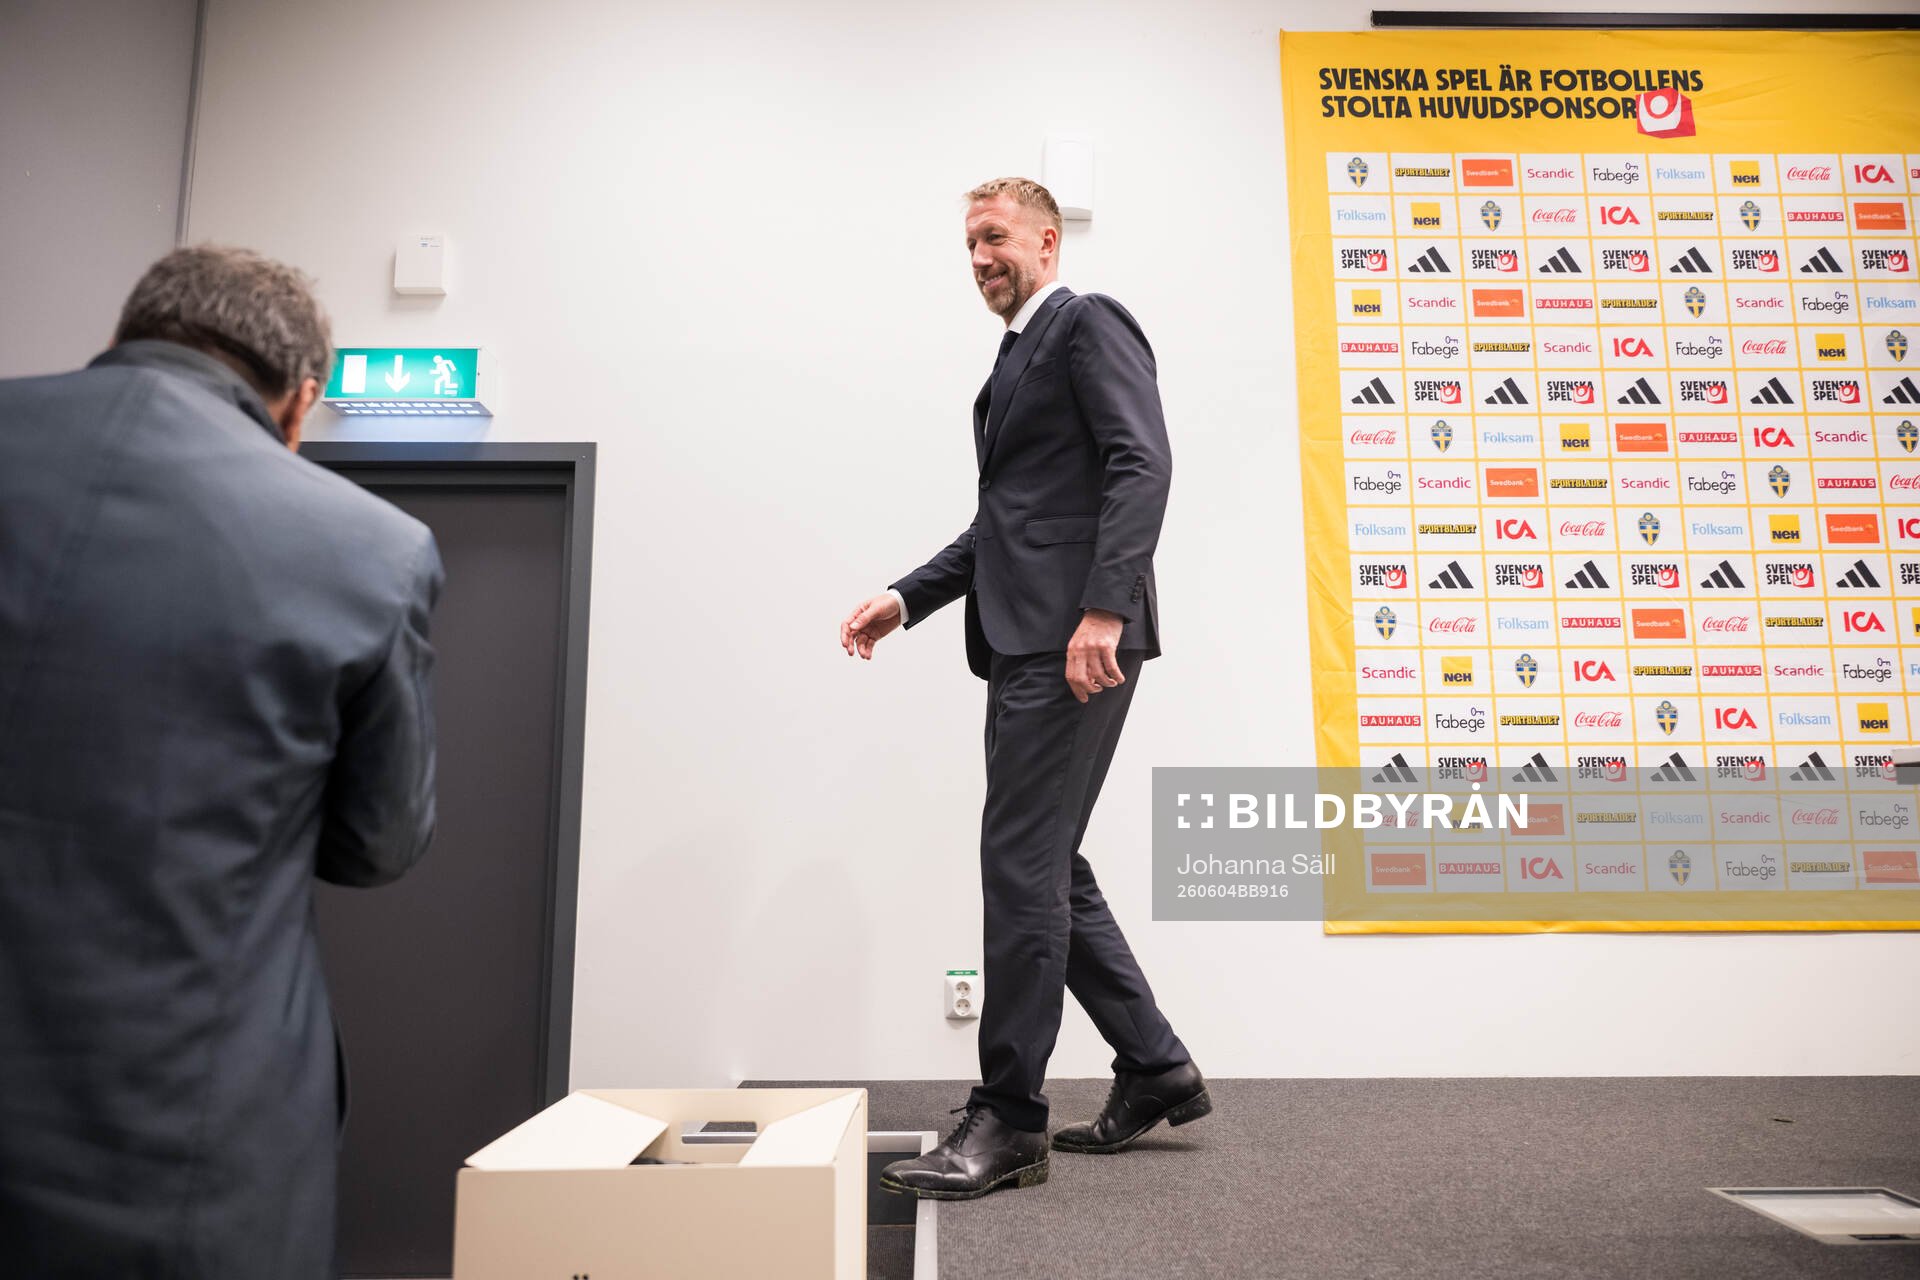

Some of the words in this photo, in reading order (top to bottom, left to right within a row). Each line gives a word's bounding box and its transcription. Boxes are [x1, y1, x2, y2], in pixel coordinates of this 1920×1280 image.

[1319, 67, 1429, 91] SVENSKA
[1437, 68, 1492, 91] SPEL
[1499, 64, 1532, 91] ÄR
[1540, 69, 1704, 92] FOTBOLLENS
[1321, 95, 1412, 118] STOLTA
[1419, 96, 1636, 119] HUVUDSPONSOR
[1395, 167, 1450, 178] SPORTBLADET
[1528, 168, 1574, 178] Scandic
[1593, 168, 1639, 184] Fabege
[1656, 168, 1705, 179] Folksam
[1855, 165, 1894, 183] ICA
[1337, 210, 1386, 220] Folksam
[1600, 206, 1640, 225] ICA
[1657, 211, 1713, 220] SPORTBLADET
[1788, 212, 1843, 221] BAUHAUS
[1342, 259, 1365, 270] SPEL
[1473, 259, 1496, 270] SPEL
[1604, 259, 1627, 270] SPEL
[1733, 259, 1756, 270] SPEL
[1863, 259, 1886, 270] SPEL
[1408, 297, 1456, 307] Scandic
[1537, 299, 1592, 308] BAUHAUS
[1601, 299, 1657, 308] SPORTBLADET
[1736, 297, 1784, 308] Scandic
[1802, 298, 1849, 314] Fabege
[1867, 297, 1916, 308] Folksam
[1342, 343, 1397, 352] BAUHAUS
[1412, 342, 1458, 359] Fabege
[1473, 342, 1530, 352] SPORTBLADET
[1544, 342, 1591, 352] Scandic
[1614, 338, 1653, 357] ICA
[1676, 342, 1722, 359] Fabege
[1415, 391, 1439, 401] SPEL
[1548, 391, 1571, 401] SPEL
[1681, 391, 1705, 401] SPEL
[1813, 391, 1837, 401] SPEL
[1484, 432, 1533, 443] Folksam
[1680, 432, 1736, 443] BAUHAUS
[1754, 428, 1794, 447] ICA
[1815, 431, 1868, 442] Scandic
[1354, 477, 1401, 494] Fabege
[1418, 477, 1471, 488] Scandic
[1550, 479, 1607, 488] SPORTBLADET
[1621, 478, 1670, 488] Scandic
[1688, 477, 1735, 494] Fabege
[1818, 478, 1875, 488] BAUHAUS
[1355, 524, 1406, 535] Folksam
[1418, 524, 1476, 534] SPORTBLADET
[1496, 519, 1536, 539] ICA
[1692, 523, 1743, 535] Folksam
[1898, 519, 1920, 539] IC
[1360, 575, 1384, 586] SPEL
[1496, 575, 1520, 586] SPEL
[1632, 575, 1656, 586] SPEL
[1767, 575, 1791, 586] SPEL
[1901, 575, 1920, 585] SPE
[1497, 618, 1549, 629] Folksam
[1562, 618, 1620, 628] BAUHAUS
[1766, 617, 1823, 627] SPORTBLADET
[1844, 612, 1885, 632] ICA
[1362, 666, 1416, 678] Scandic
[1574, 661, 1616, 681] ICA
[1633, 666, 1691, 676] SPORTBLADET
[1703, 666, 1761, 676] BAUHAUS
[1775, 665, 1824, 676] Scandic
[1843, 665, 1891, 682] Fabege
[1361, 716, 1420, 726] BAUHAUS
[1436, 714, 1485, 732] Fabege
[1500, 715, 1559, 725] SPORTBLADET
[1715, 708, 1757, 729] ICA
[1779, 713, 1831, 725] Folksam
[1438, 768, 1464, 780] SPEL
[1578, 768, 1603, 780] SPEL
[1717, 768, 1742, 780] SPEL
[1856, 768, 1881, 778] SPEL
[1576, 812, 1637, 823] SPORTBLADET
[1651, 812, 1703, 824] Folksam
[1721, 812, 1770, 823] Scandic
[1860, 810, 1909, 829] Fabege
[1440, 863, 1499, 873] BAUHAUS
[1521, 857, 1563, 879] ICA
[1586, 863, 1636, 874] Scandic
[1726, 861, 1776, 880] Fabege
[1790, 862, 1850, 872] SPORTBLADET
